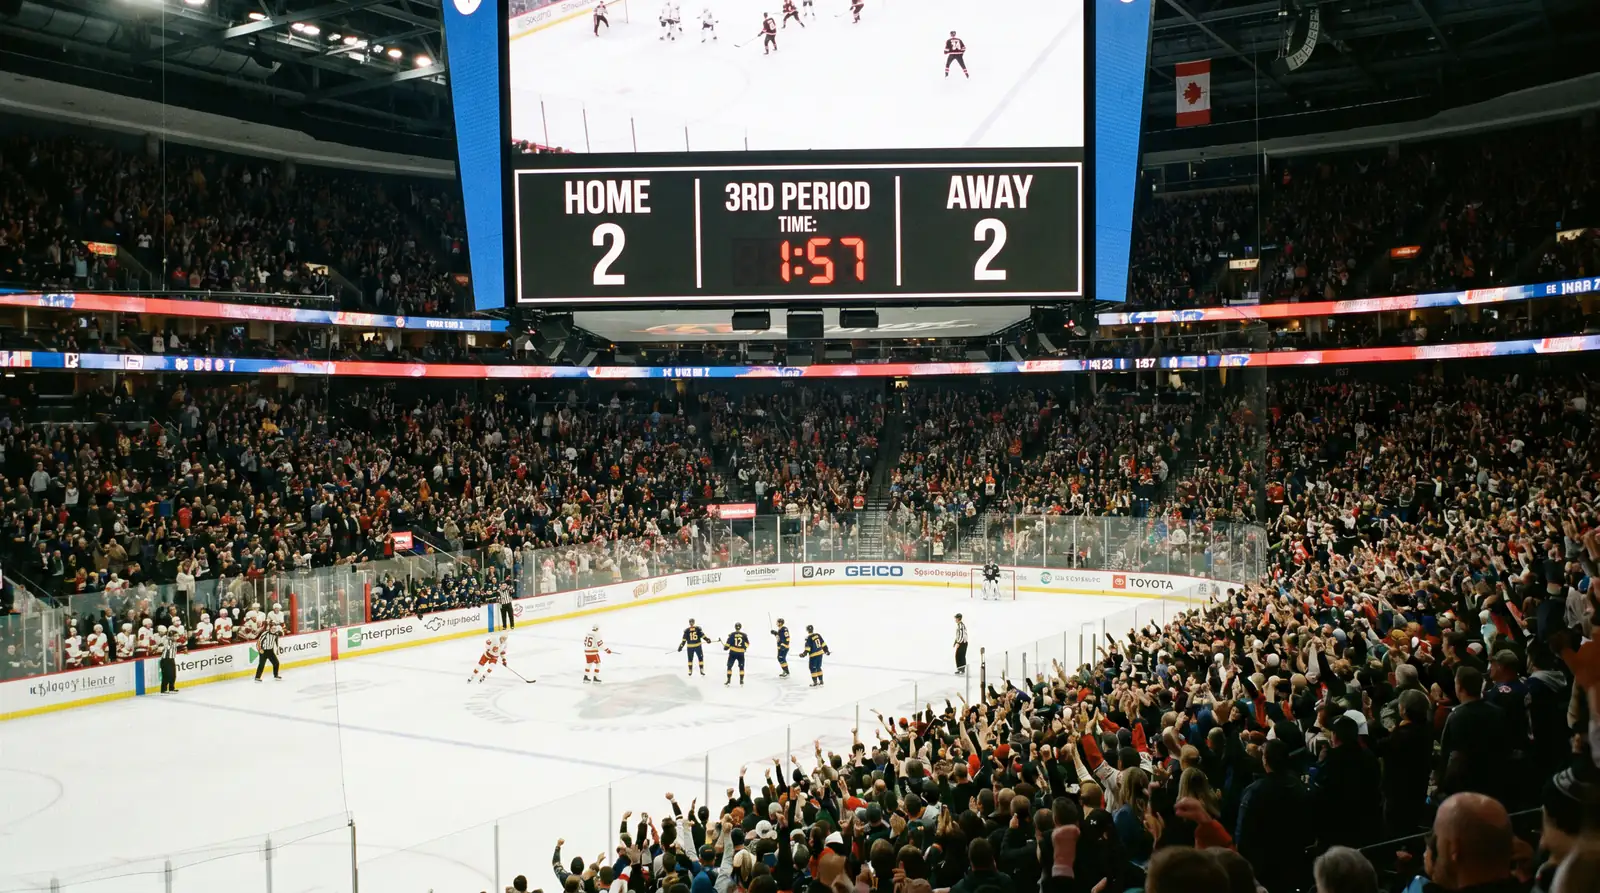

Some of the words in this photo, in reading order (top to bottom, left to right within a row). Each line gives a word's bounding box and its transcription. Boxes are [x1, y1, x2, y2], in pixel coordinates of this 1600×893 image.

[565, 179, 651, 214] HOME
[725, 182, 774, 212] 3RD
[781, 181, 871, 211] PERIOD
[947, 174, 1034, 209] AWAY
[778, 215, 818, 233] TIME:
[592, 222, 626, 286] 2
[780, 236, 866, 284] 1:57
[974, 217, 1007, 281] 2
[845, 565, 904, 577] GEICO
[1129, 578, 1174, 590] TOYOTA
[351, 623, 413, 643] enterprise
[734, 637, 743, 647] 12
[176, 653, 233, 672] nterprise
